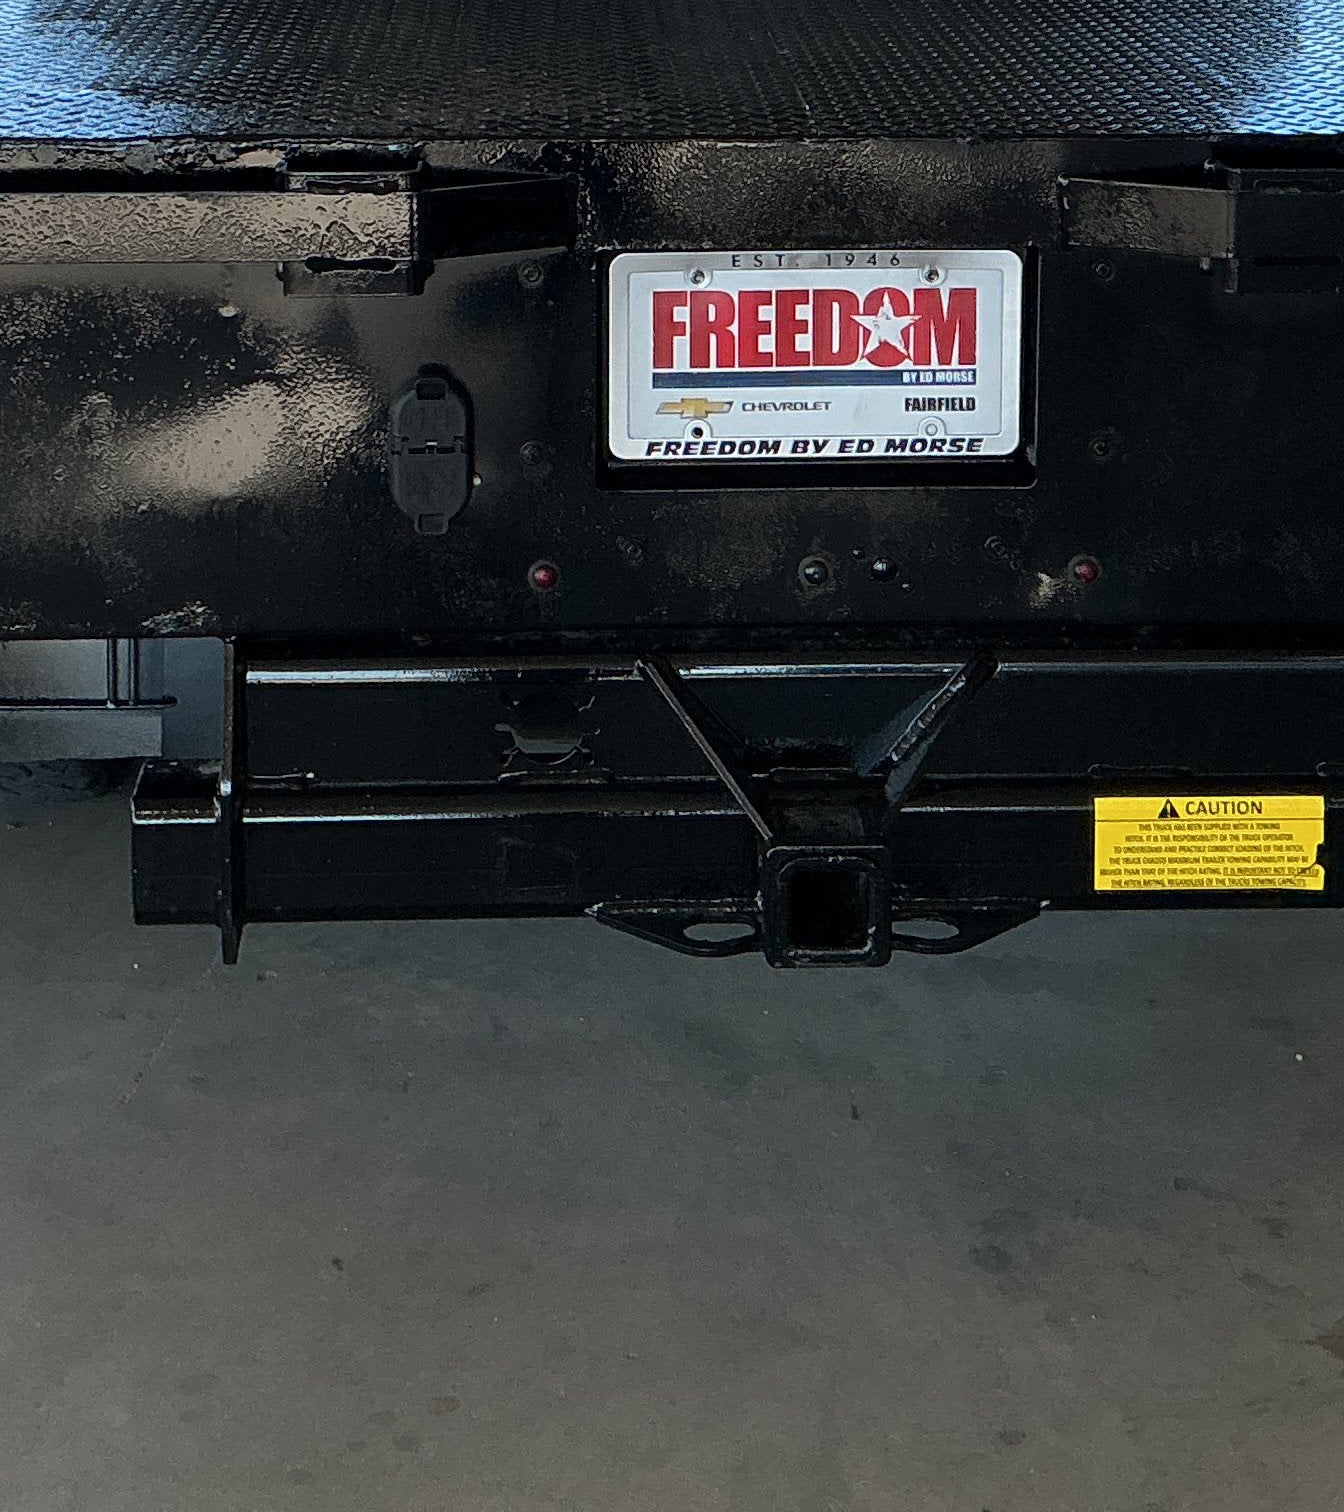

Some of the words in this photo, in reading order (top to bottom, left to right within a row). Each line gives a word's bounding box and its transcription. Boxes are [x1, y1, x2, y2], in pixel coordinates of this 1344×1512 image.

[825, 253, 901, 266] 1946
[652, 286, 977, 369] FREEDOM
[902, 371, 917, 383] BY
[919, 371, 933, 383] ED
[935, 370, 974, 383] MORSE
[741, 401, 832, 412] CHEVROLET
[904, 396, 976, 412] FAIRFIELD
[645, 440, 782, 457] FREEDOM
[791, 439, 830, 455] BY
[837, 439, 875, 454] ED
[884, 438, 984, 454] MORSE
[1185, 800, 1263, 816] CAUTION
